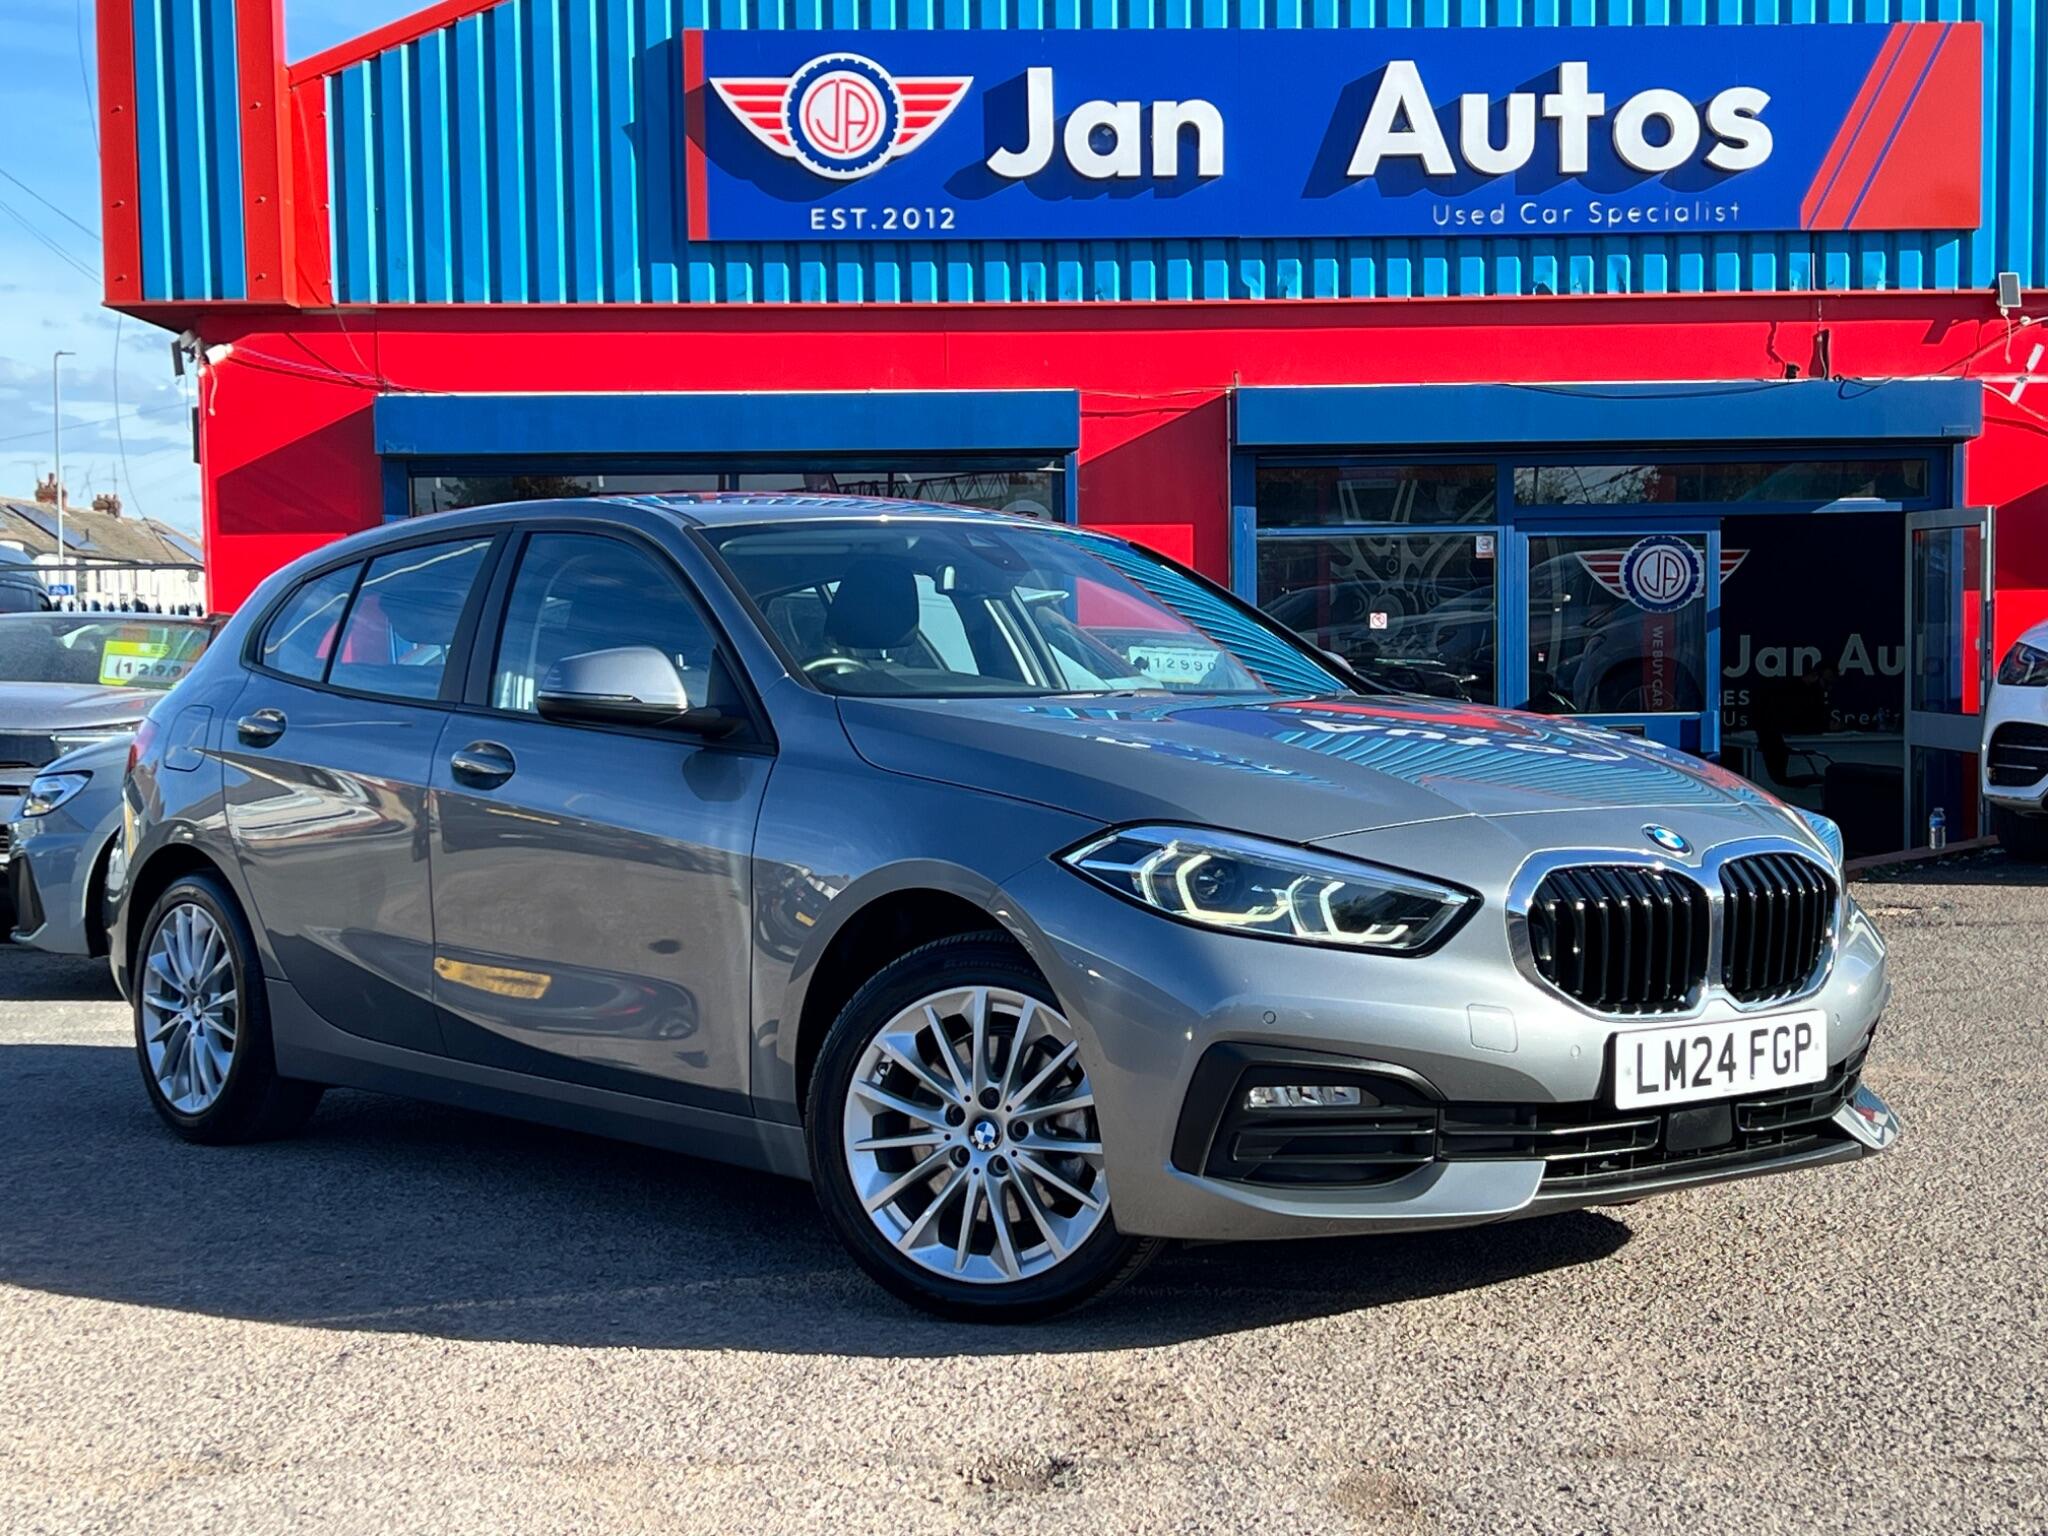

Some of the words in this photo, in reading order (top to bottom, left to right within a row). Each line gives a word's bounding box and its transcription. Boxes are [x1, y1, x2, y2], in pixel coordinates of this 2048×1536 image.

[986, 66, 1224, 178] Jan
[1347, 60, 1774, 176] Autos
[810, 206, 955, 230] EST.2012
[1432, 203, 1505, 226] Used
[1519, 203, 1574, 225] Car
[1587, 201, 1741, 226] Specialist
[1722, 634, 1822, 678] Jan
[1636, 1032, 1737, 1095] LM24
[1749, 1022, 1812, 1080] FGP
